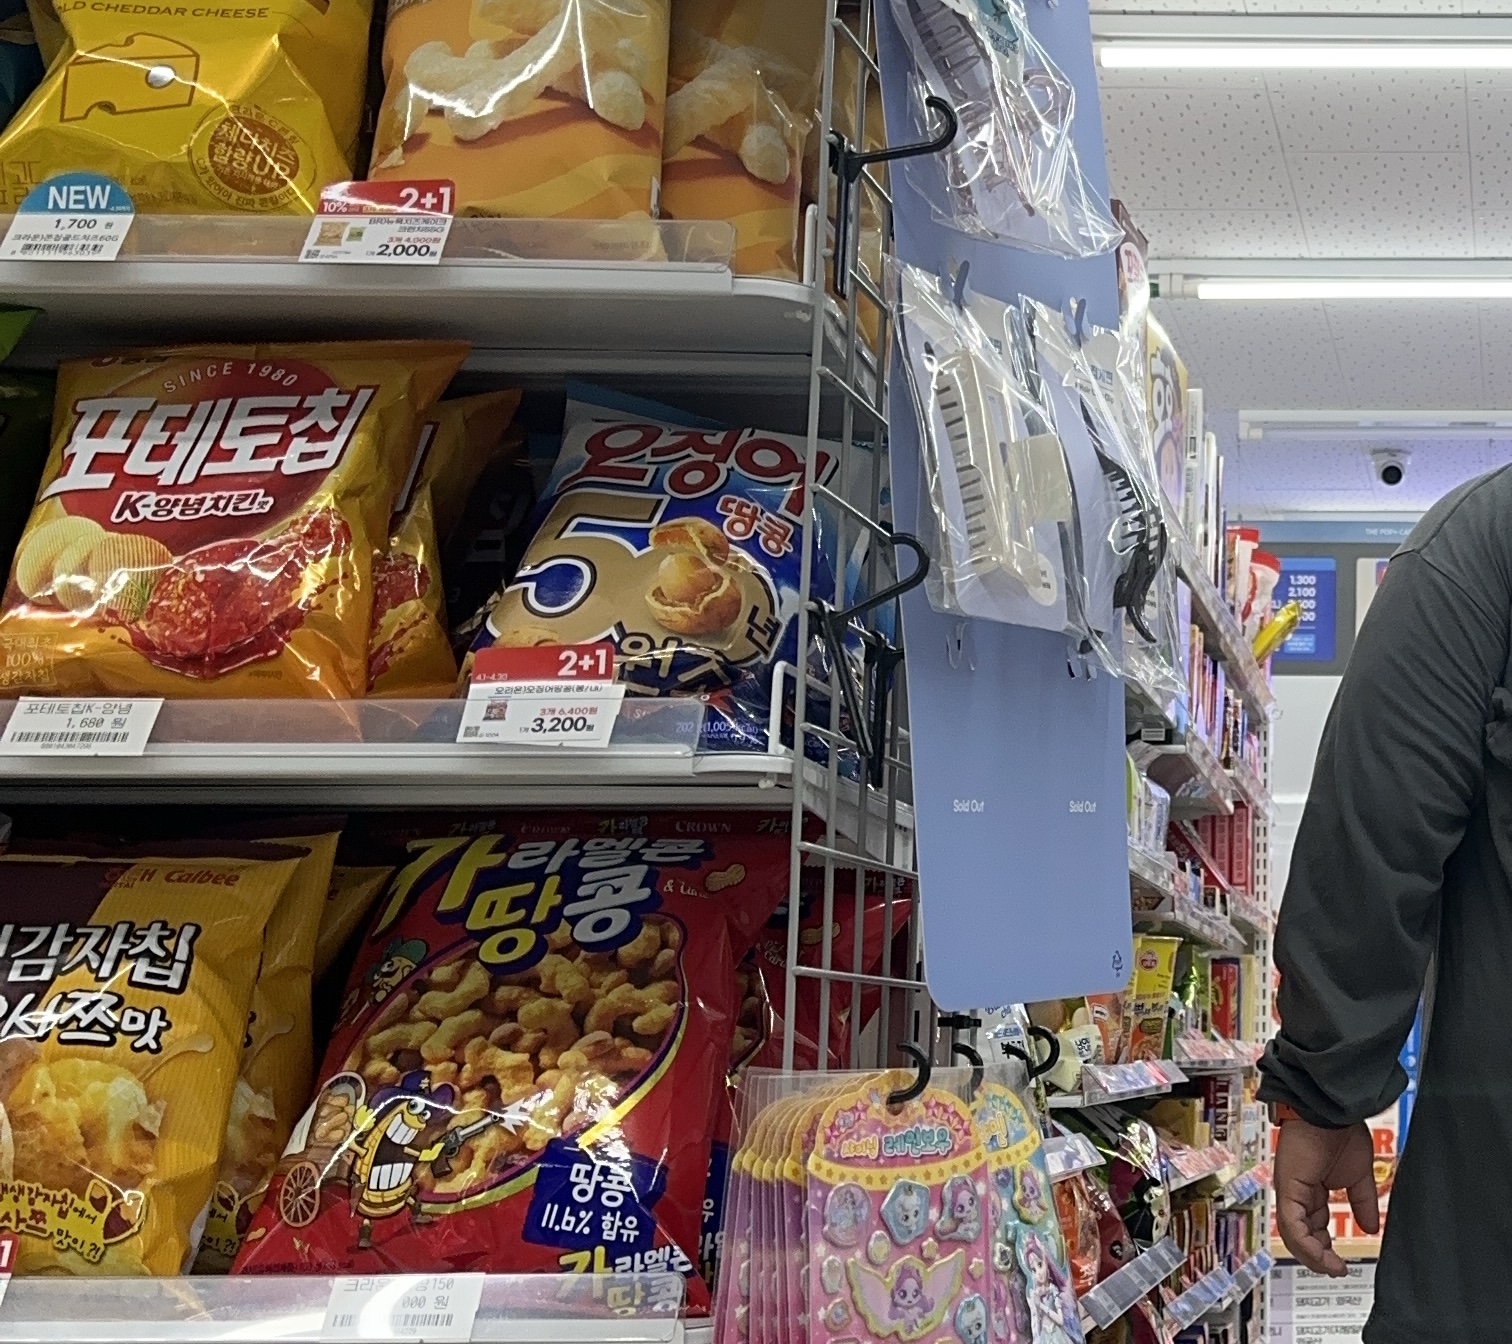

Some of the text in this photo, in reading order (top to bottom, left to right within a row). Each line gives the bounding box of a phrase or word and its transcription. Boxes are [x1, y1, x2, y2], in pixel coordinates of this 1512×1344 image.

[90, 1, 269, 19] CHEDDAR CHEESE
[48, 185, 112, 211] NEW
[399, 186, 452, 214] 2+1
[53, 218, 98, 231] 1,700
[163, 361, 299, 394] SINCE 1980
[40, 387, 376, 502] 포테토칩
[557, 422, 832, 518] 오징어
[718, 494, 795, 558] 땅콩
[557, 648, 607, 677] 2+1
[952, 799, 985, 814] Sold Out
[1068, 801, 1097, 814] Sold Out
[163, 868, 241, 888] Calbee
[370, 833, 706, 940] 카라멜콘
[464, 864, 652, 965] 땅콩
[0, 921, 197, 990] 감자칩
[119, 1007, 169, 1052] 맛
[882, 1126, 952, 1157] 레인보우
[569, 1161, 632, 1208] 땅콩
[541, 1202, 641, 1244] 11.6% 함유
